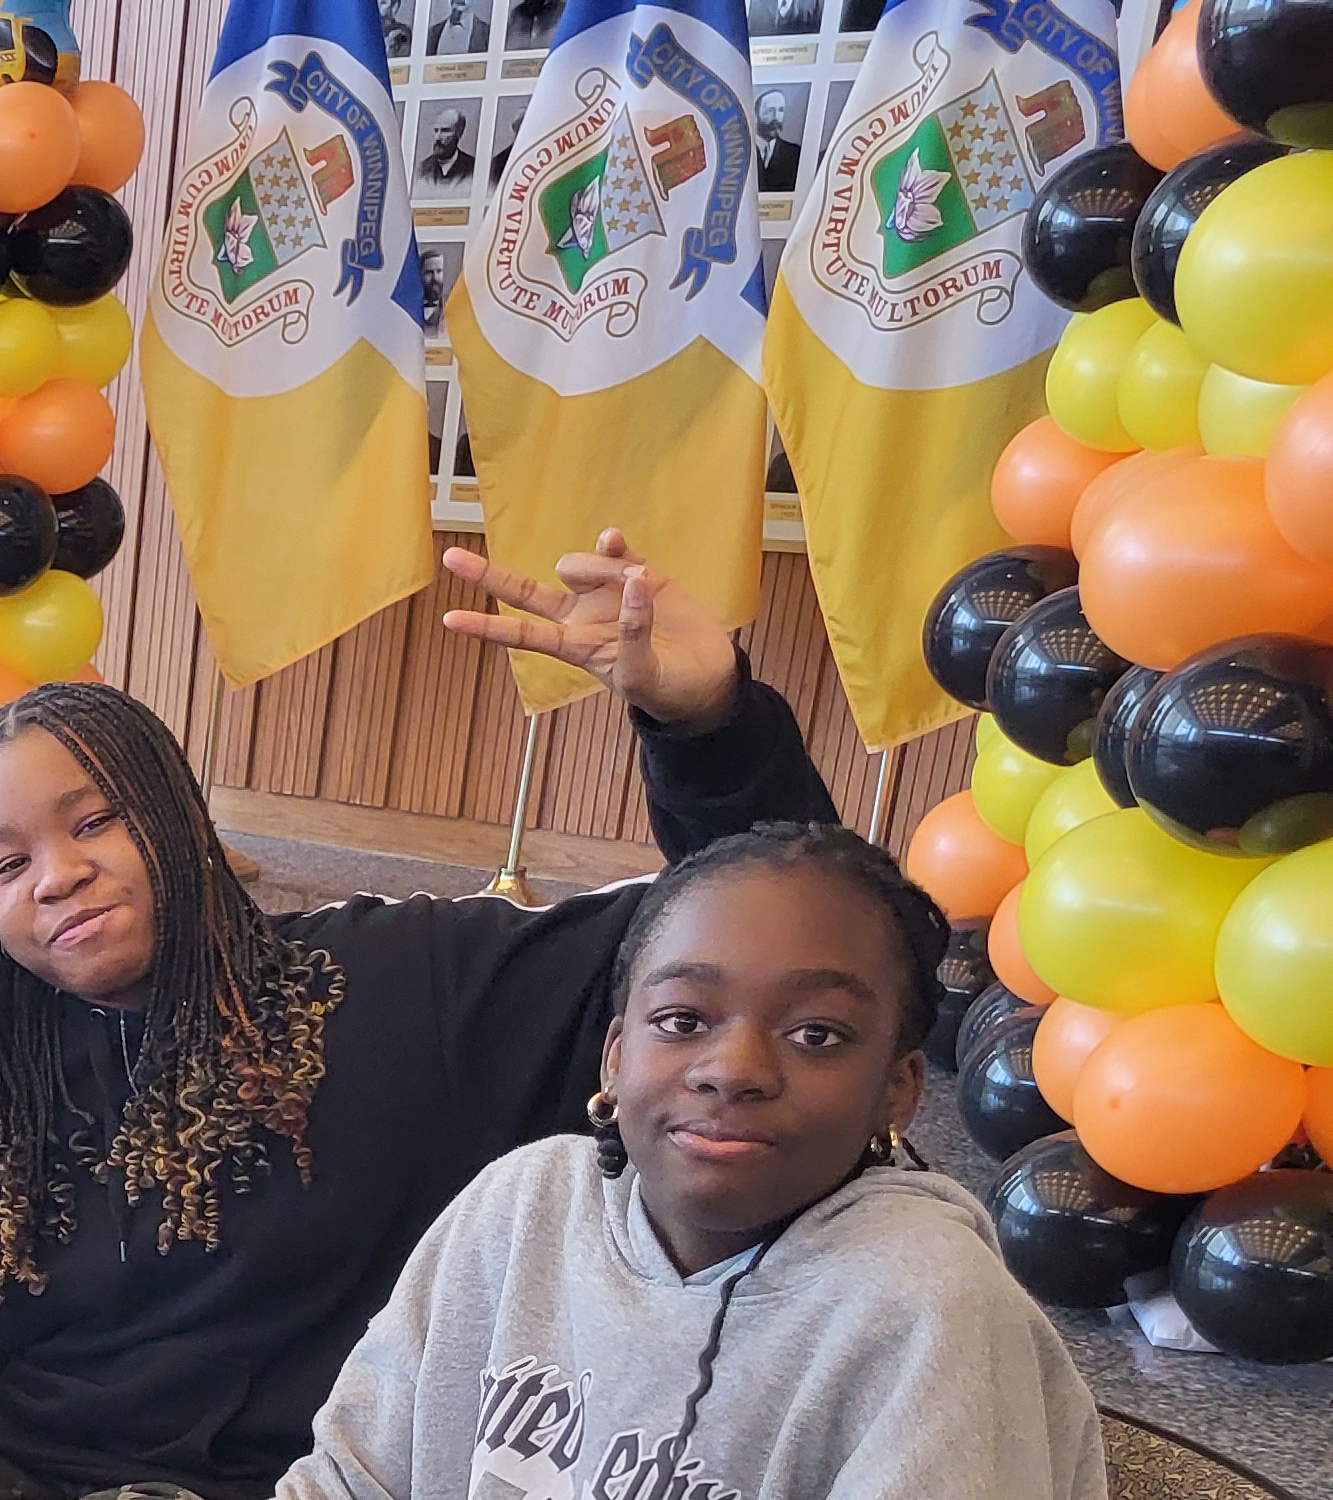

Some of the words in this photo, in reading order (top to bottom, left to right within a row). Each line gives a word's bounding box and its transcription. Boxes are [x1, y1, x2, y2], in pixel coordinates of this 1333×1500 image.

[652, 44, 704, 87] CITY
[1023, 5, 1072, 53] CITY
[1076, 44, 1112, 74] OF
[552, 97, 617, 156] UNUM
[700, 82, 731, 113] OF
[305, 70, 350, 111] CITY
[346, 108, 370, 131] OF
[359, 131, 383, 257] WINNIPEG
[507, 149, 553, 205] CUM
[836, 120, 887, 178] CUM
[176, 172, 213, 219] CUM
[708, 113, 745, 248] WINNIPEG
[168, 222, 210, 317] VIRTUTE
[496, 208, 542, 311] VIRTUTE
[821, 184, 870, 296] VIRTUTE
[542, 276, 630, 335] MUORUM
[867, 258, 1003, 323] MULTORUM
